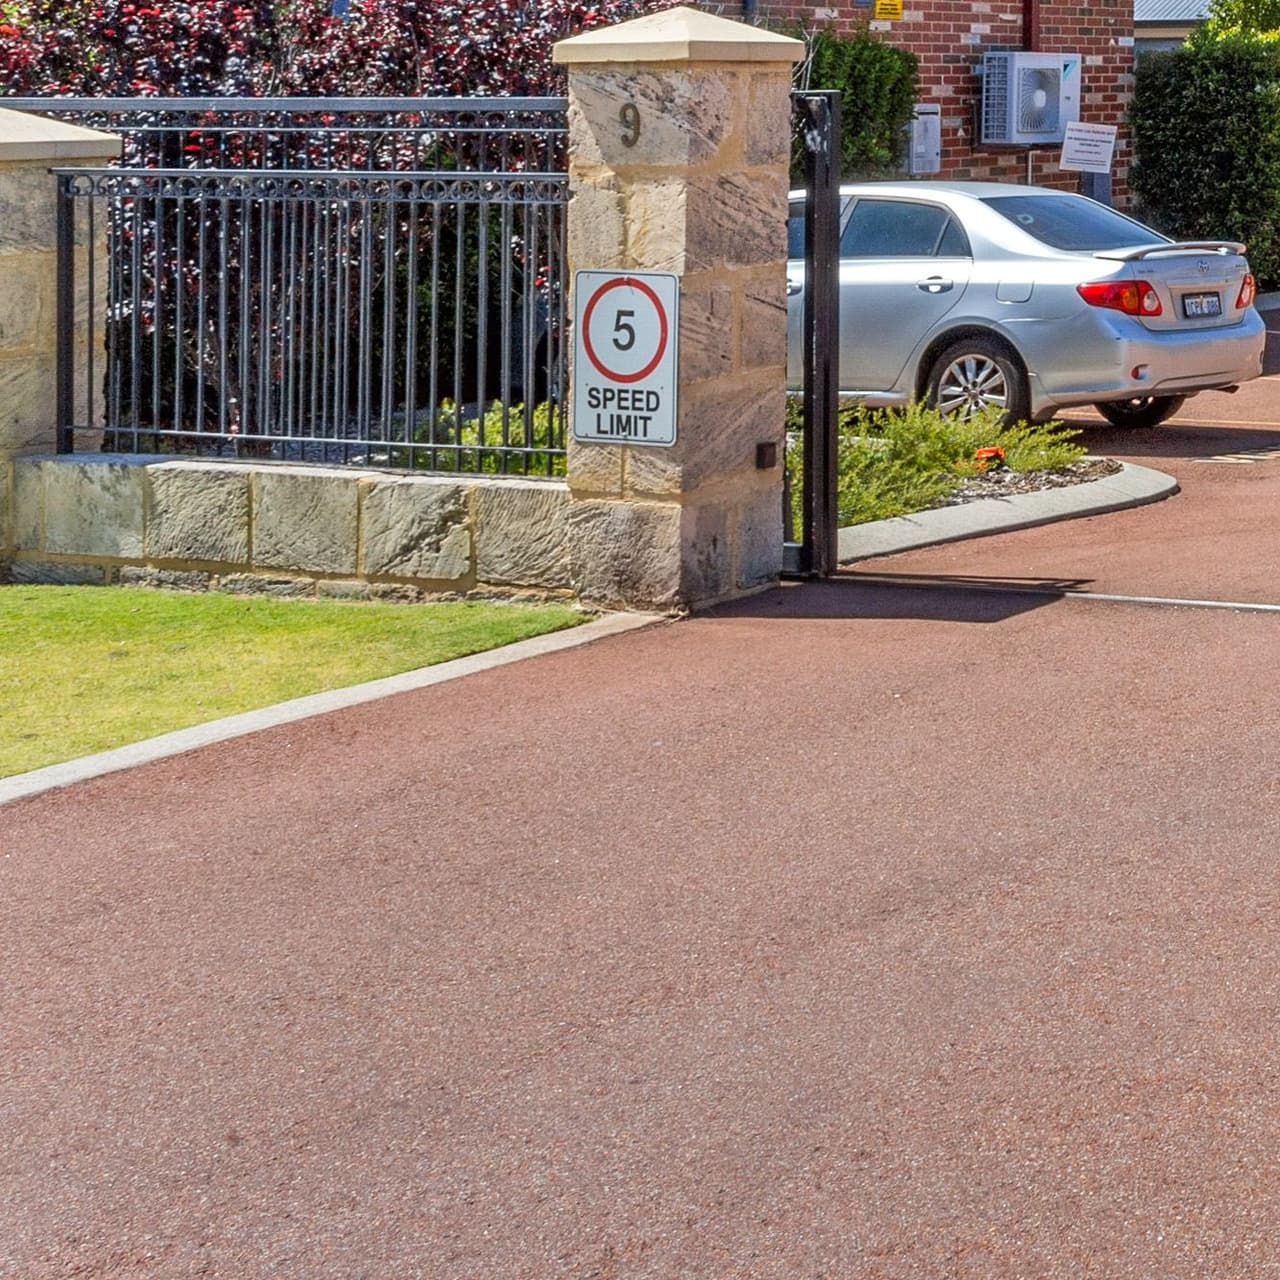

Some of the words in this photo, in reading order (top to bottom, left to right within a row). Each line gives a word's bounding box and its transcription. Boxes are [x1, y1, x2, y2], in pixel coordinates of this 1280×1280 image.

[620, 102, 640, 148] 9
[612, 309, 636, 351] 5
[587, 387, 661, 413] SPEED
[596, 413, 652, 438] LIMIT
